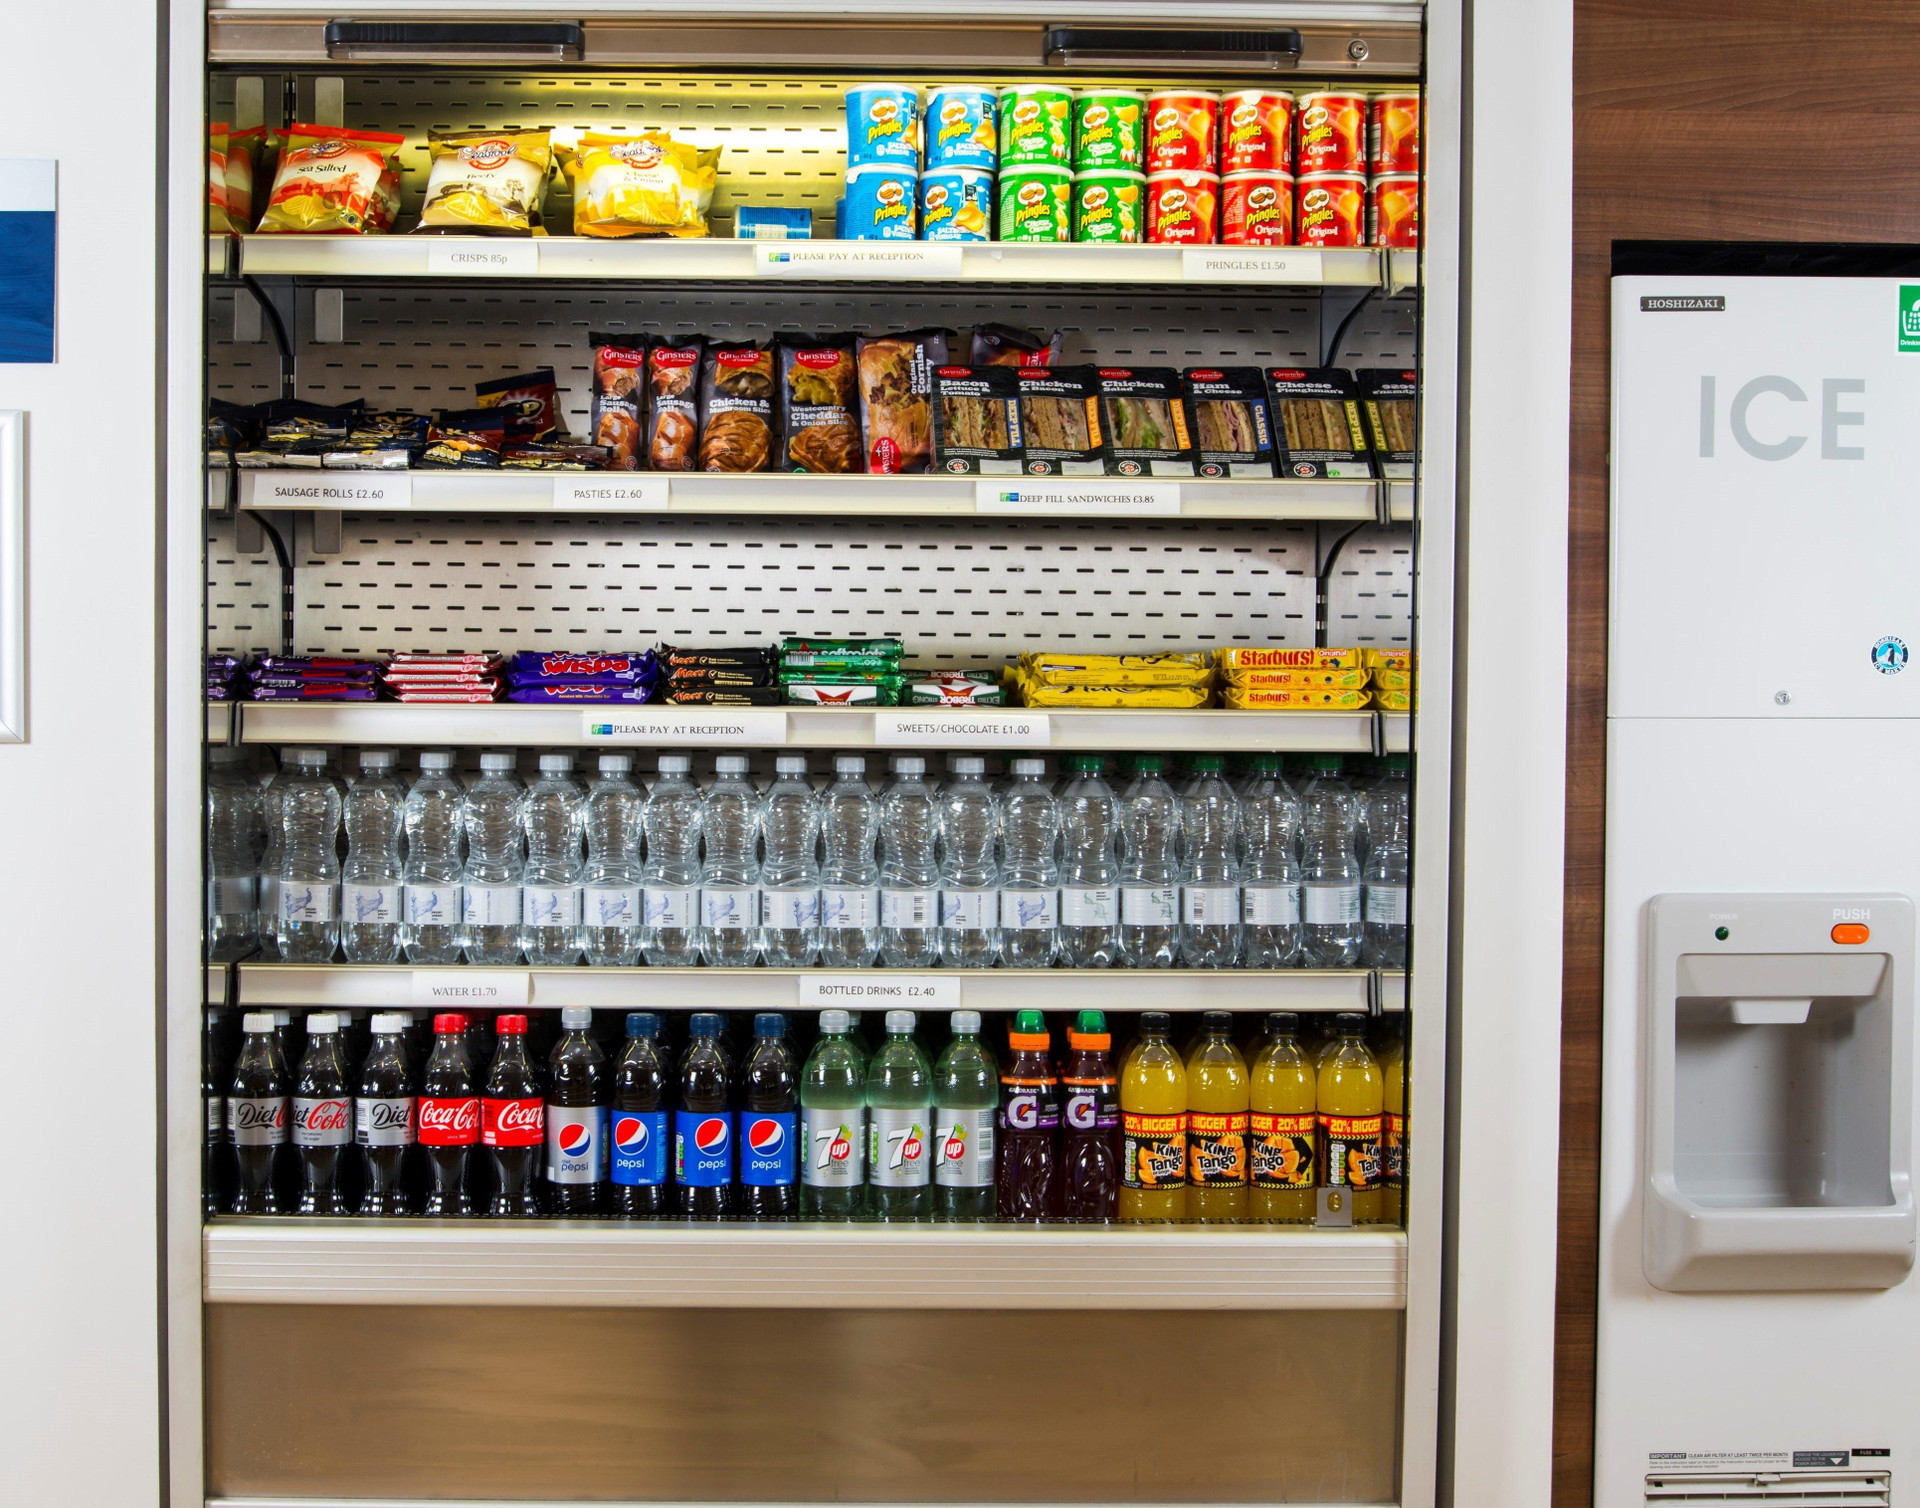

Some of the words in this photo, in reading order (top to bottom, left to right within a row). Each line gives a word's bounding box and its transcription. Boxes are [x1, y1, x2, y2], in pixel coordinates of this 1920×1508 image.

[868, 118, 902, 144] Pringles
[938, 119, 972, 146] Pringles
[1011, 119, 1044, 146] Pringles
[1229, 123, 1262, 149] Pringles
[1081, 124, 1113, 151] Pringles
[1152, 126, 1183, 153] Pringles
[1301, 125, 1333, 152] Pringles
[1158, 146, 1187, 157] Original
[1236, 142, 1266, 153] Original
[1308, 143, 1337, 155] Original
[297, 165, 313, 174] Sea
[315, 163, 347, 173] Salted
[874, 202, 907, 226] Pringles
[923, 203, 953, 231] Pringles
[1015, 202, 1050, 227] Pringles
[1080, 205, 1113, 231] Pringles
[1246, 205, 1280, 231] Pringles
[1157, 208, 1192, 234] Pringles
[1302, 207, 1334, 234] Pringles
[1164, 227, 1196, 238] Original
[1254, 224, 1284, 236] Original
[1308, 226, 1338, 238] Original
[451, 253, 489, 263] CRISPS
[490, 253, 508, 265] 85p
[792, 252, 827, 261] PLEASE
[829, 253, 849, 261] PAY
[852, 253, 866, 261] AT
[869, 253, 924, 261] RECEPTION
[1206, 261, 1259, 270] PRINGLES
[1261, 261, 1286, 270] £1.50
[1648, 299, 1719, 309] HOSHIZAKI
[916, 344, 924, 394] Cornish
[940, 380, 990, 388] Bacon
[1019, 380, 1083, 390] Chicken
[1101, 381, 1166, 389] Chicken
[1275, 382, 1332, 390] Cheese
[599, 399, 638, 412] Sausage
[656, 398, 695, 410] Sausage
[709, 397, 757, 408] Chicken
[759, 399, 770, 408] &
[791, 404, 847, 413] Westcountry
[600, 405, 620, 413] Roll
[709, 406, 751, 414] Mushroom
[791, 411, 846, 421] Cheddar
[1699, 375, 1866, 462] ICE
[1254, 405, 1268, 445] CLASSIC
[275, 487, 320, 498] SAUSAGE
[323, 489, 353, 498] ROLLS
[357, 489, 384, 499] £2.60
[574, 489, 612, 499] PASTIES
[615, 489, 642, 499] £2.60
[1020, 495, 1043, 503] DEEP
[1045, 495, 1065, 503] FILL
[1067, 495, 1131, 504] SANDWICHES
[1133, 496, 1155, 504] £3.85
[1240, 650, 1315, 666] Starburst
[1318, 650, 1347, 658] Original
[1250, 674, 1291, 684] Starburst
[912, 695, 938, 703] STRONG
[940, 696, 975, 704] TREBOR
[1249, 693, 1290, 702] Starburst
[614, 725, 647, 734] PLEASE
[649, 726, 670, 734] PAY
[672, 726, 686, 734] AT
[689, 726, 745, 734] RECEPTION
[897, 724, 999, 734] SWEETS/CHOCOLATE
[1002, 725, 1030, 735] £1.00
[1833, 908, 1871, 920] PUSH
[432, 987, 469, 996] WATER
[471, 987, 497, 996] £1.70
[819, 985, 864, 995] BOTTLED
[867, 986, 902, 996] DRINKS
[908, 987, 935, 997] £2.40
[237, 1102, 278, 1128] Diet
[292, 1105, 309, 1124] iet
[307, 1101, 350, 1130] Coke
[371, 1102, 412, 1128] Diet
[1008, 1095, 1037, 1129] G
[1067, 1095, 1095, 1129] G
[1125, 1116, 1141, 1130] 20%
[1142, 1118, 1177, 1131] BIGGER
[1192, 1117, 1227, 1130] BIGGER
[1277, 1118, 1298, 1131] 20%
[1331, 1119, 1350, 1132] 20%
[1352, 1118, 1381, 1132] BIGGER
[561, 1162, 589, 1173] pepsi
[616, 1158, 645, 1170] pepsi
[698, 1158, 727, 1171] pepsi
[751, 1159, 782, 1171] pepsi
[1148, 1155, 1183, 1171] Tango
[1197, 1155, 1237, 1170] Tango
[1250, 1155, 1284, 1170] Tango
